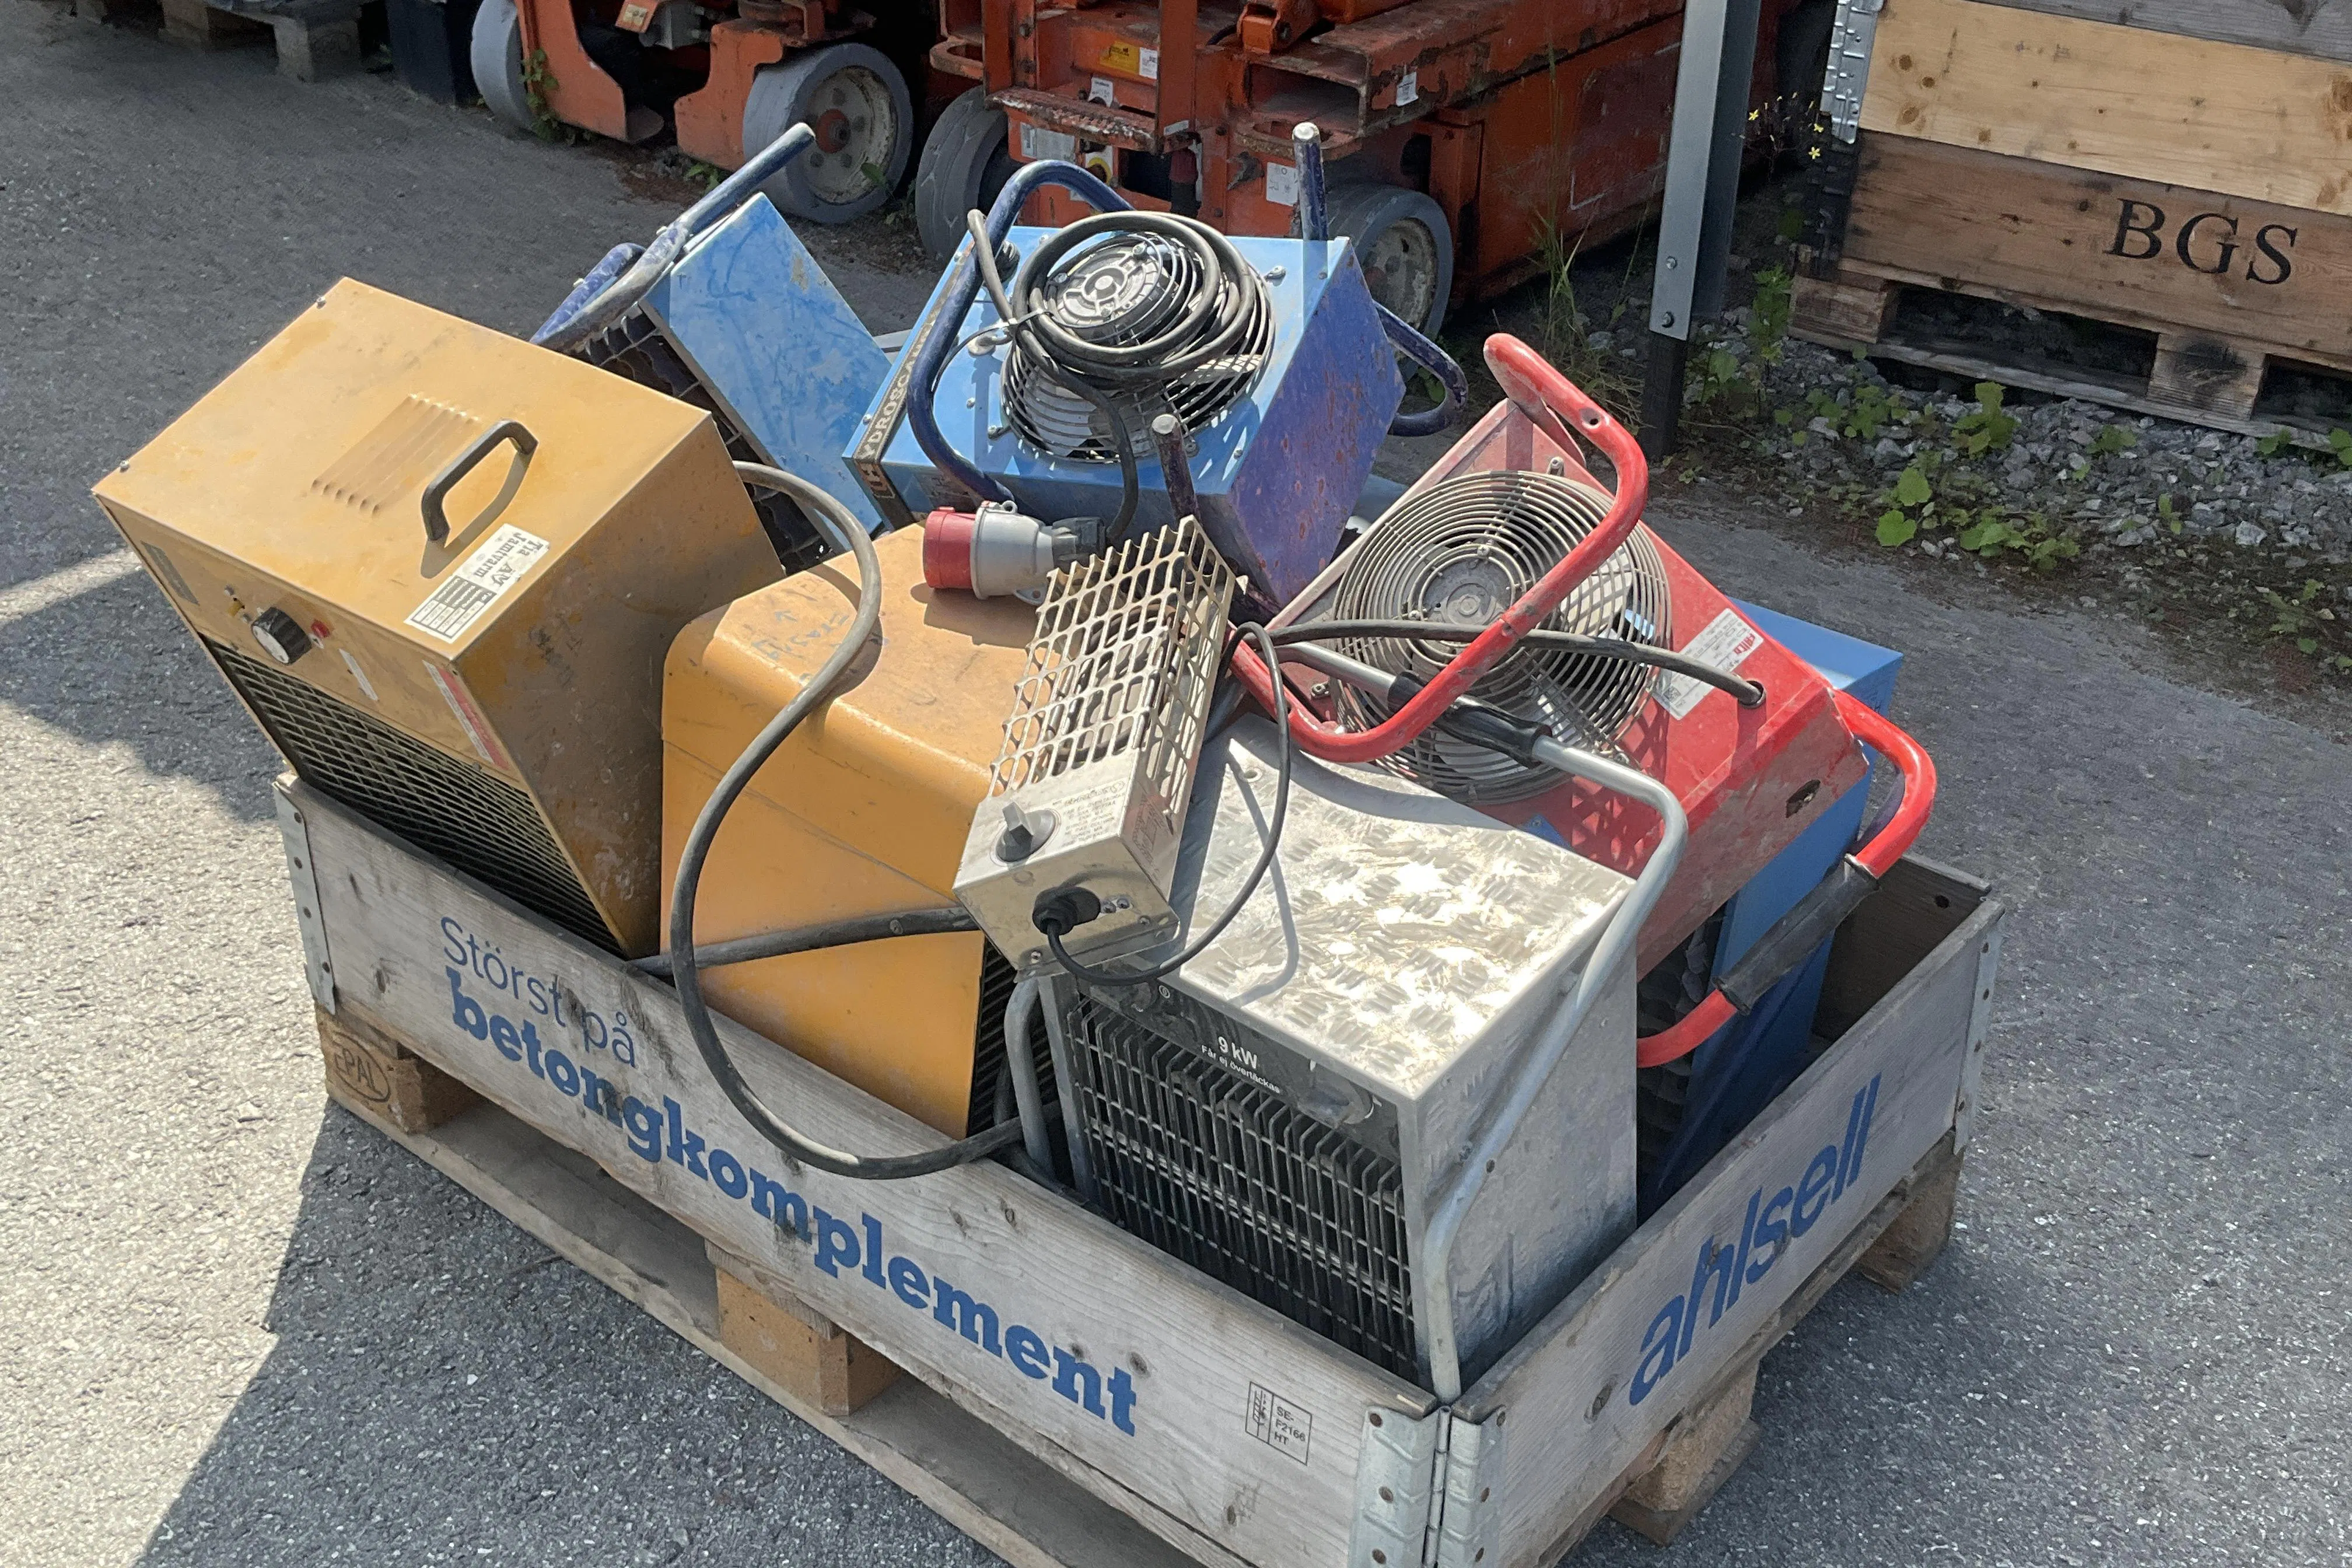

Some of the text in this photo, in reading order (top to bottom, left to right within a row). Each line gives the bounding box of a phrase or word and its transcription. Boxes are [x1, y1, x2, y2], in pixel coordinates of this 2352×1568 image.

[2102, 198, 2298, 285] BGS
[440, 916, 637, 1068] Störst på
[1201, 1045, 1216, 1059] Får
[1219, 1056, 1227, 1068] ej
[1218, 1036, 1258, 1069] 9 kW
[445, 965, 1137, 1437] betongkomplement
[1629, 1072, 1882, 1406] ahlsell
[1274, 1432, 1289, 1445] HT
[1277, 1406, 1294, 1421] SE-
